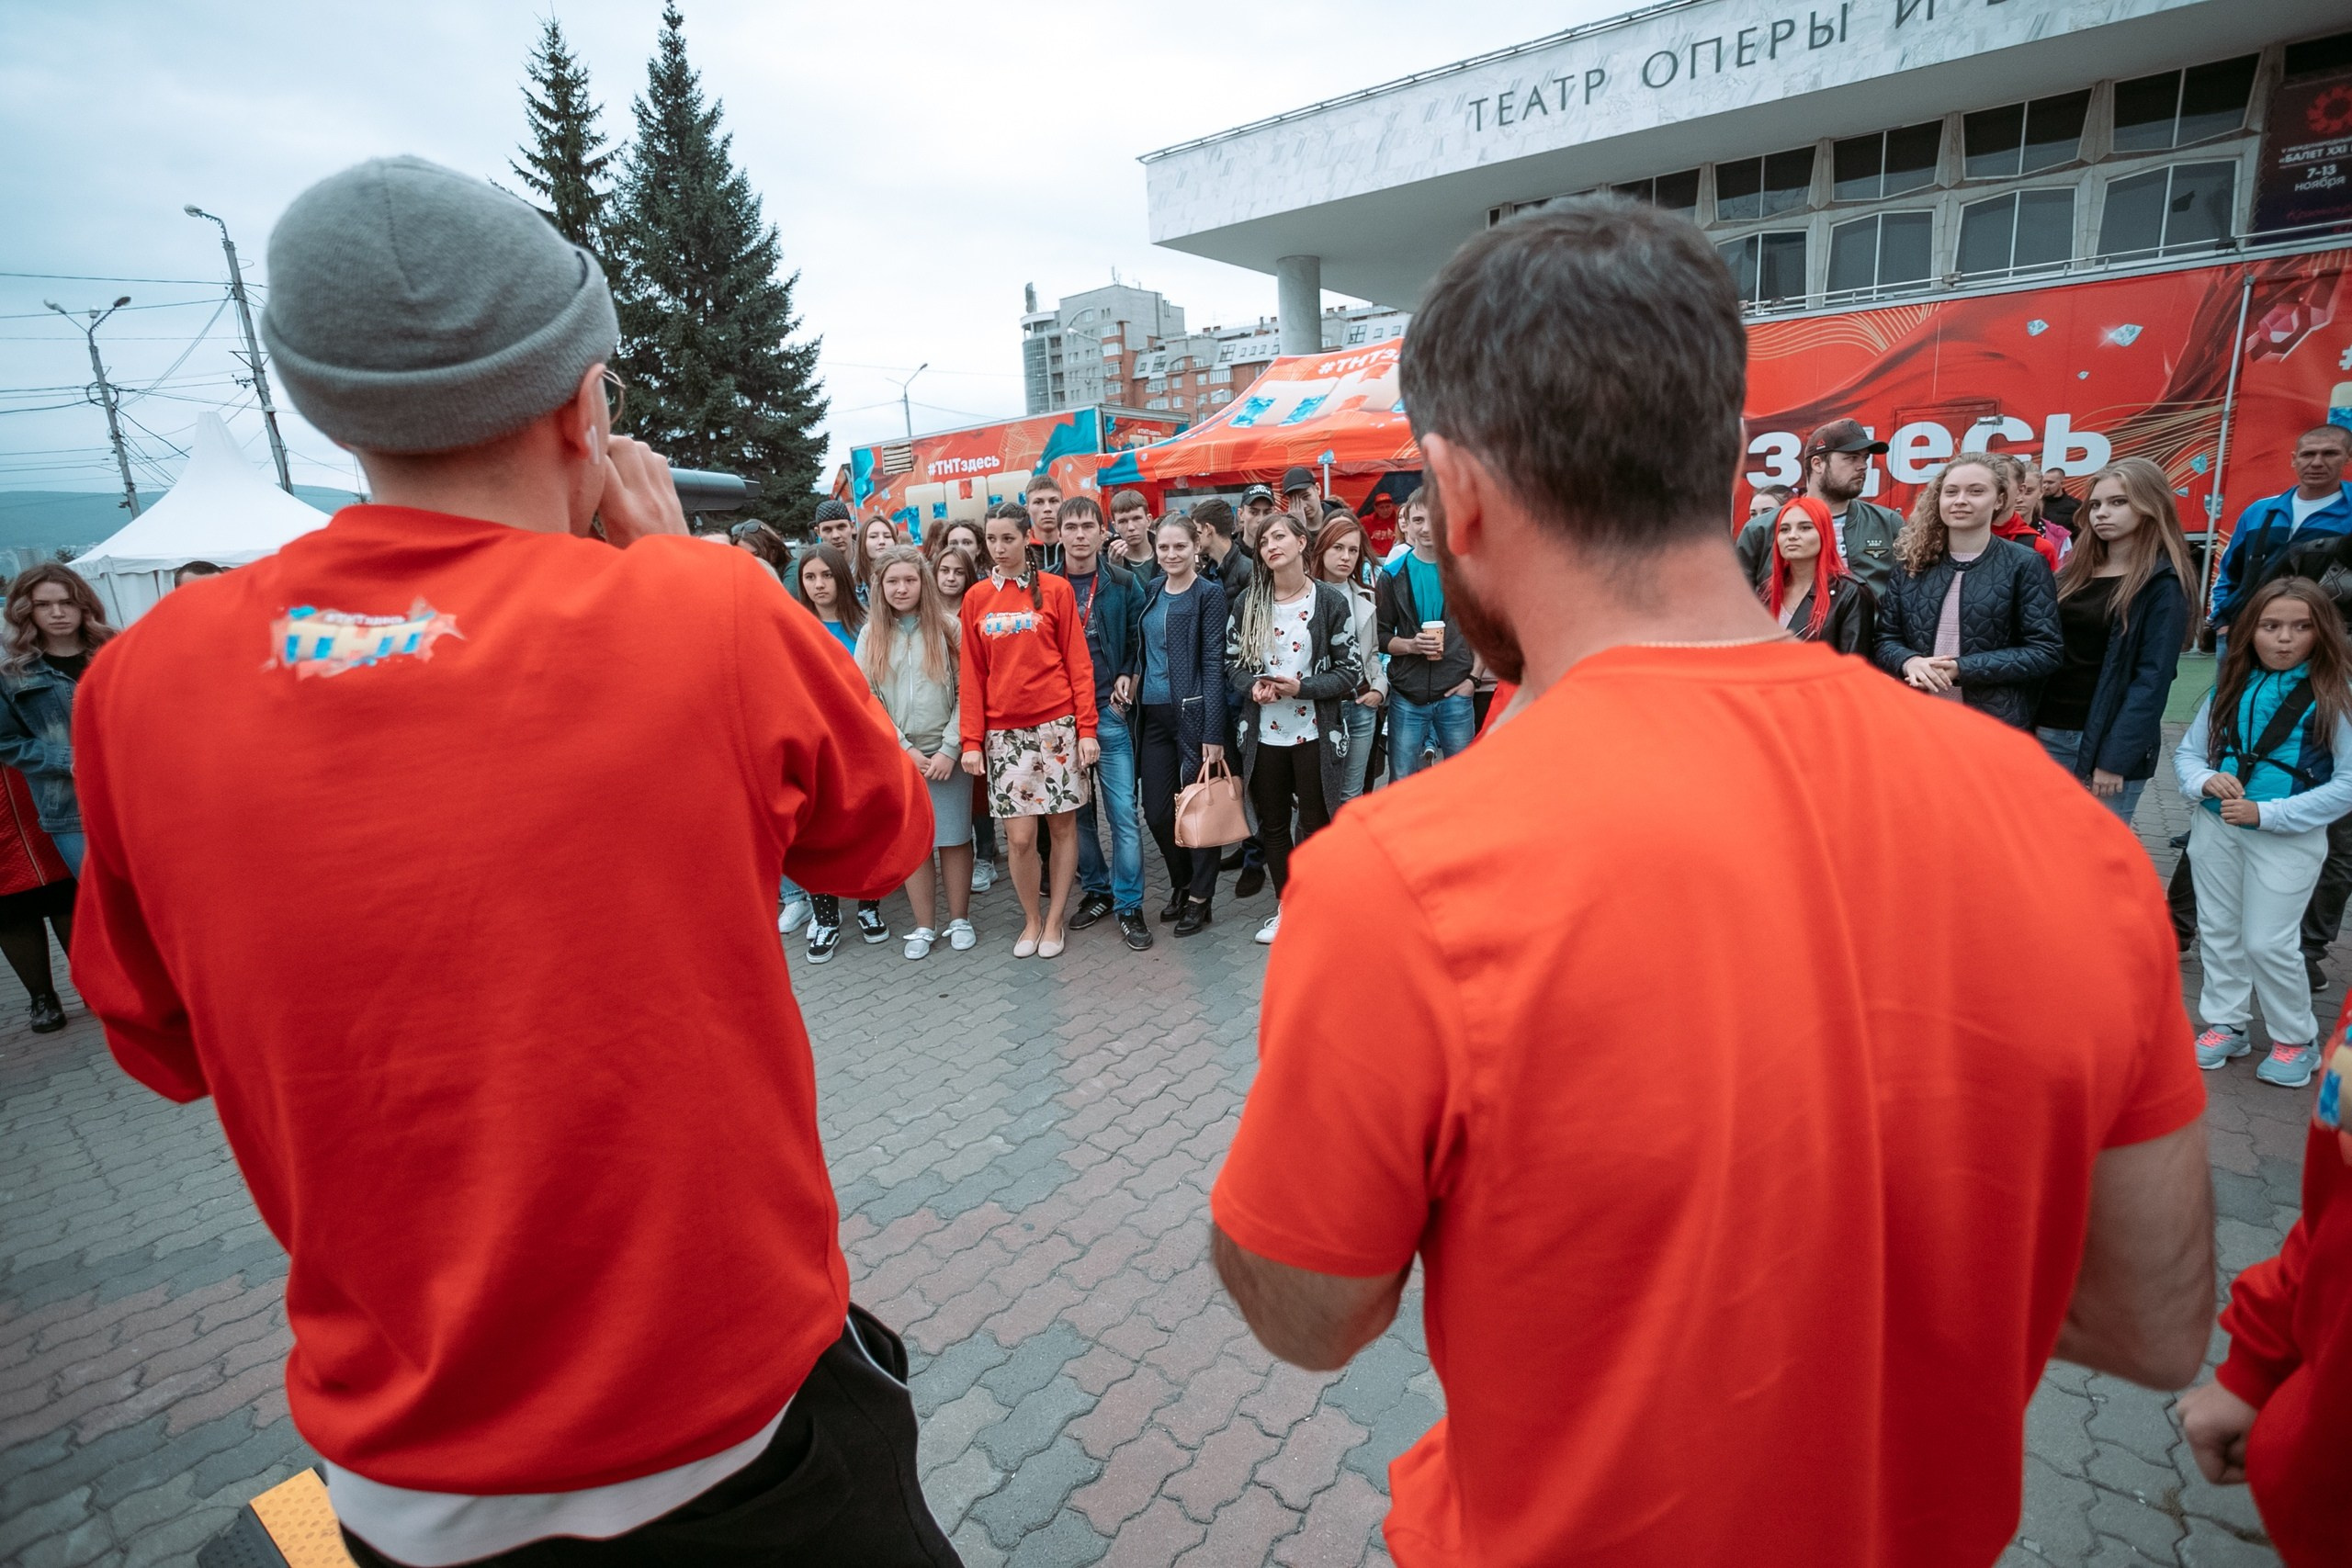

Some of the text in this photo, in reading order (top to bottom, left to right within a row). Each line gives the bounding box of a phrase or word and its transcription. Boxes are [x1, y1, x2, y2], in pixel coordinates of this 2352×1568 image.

[1468, 69, 1606, 131] ТЕАТР
[1642, 3, 1847, 88] ОПЕРЫ
[2307, 164, 2336, 178] 7-13
[2295, 175, 2346, 191] ноября
[928, 456, 1000, 476] #ТНТздесь
